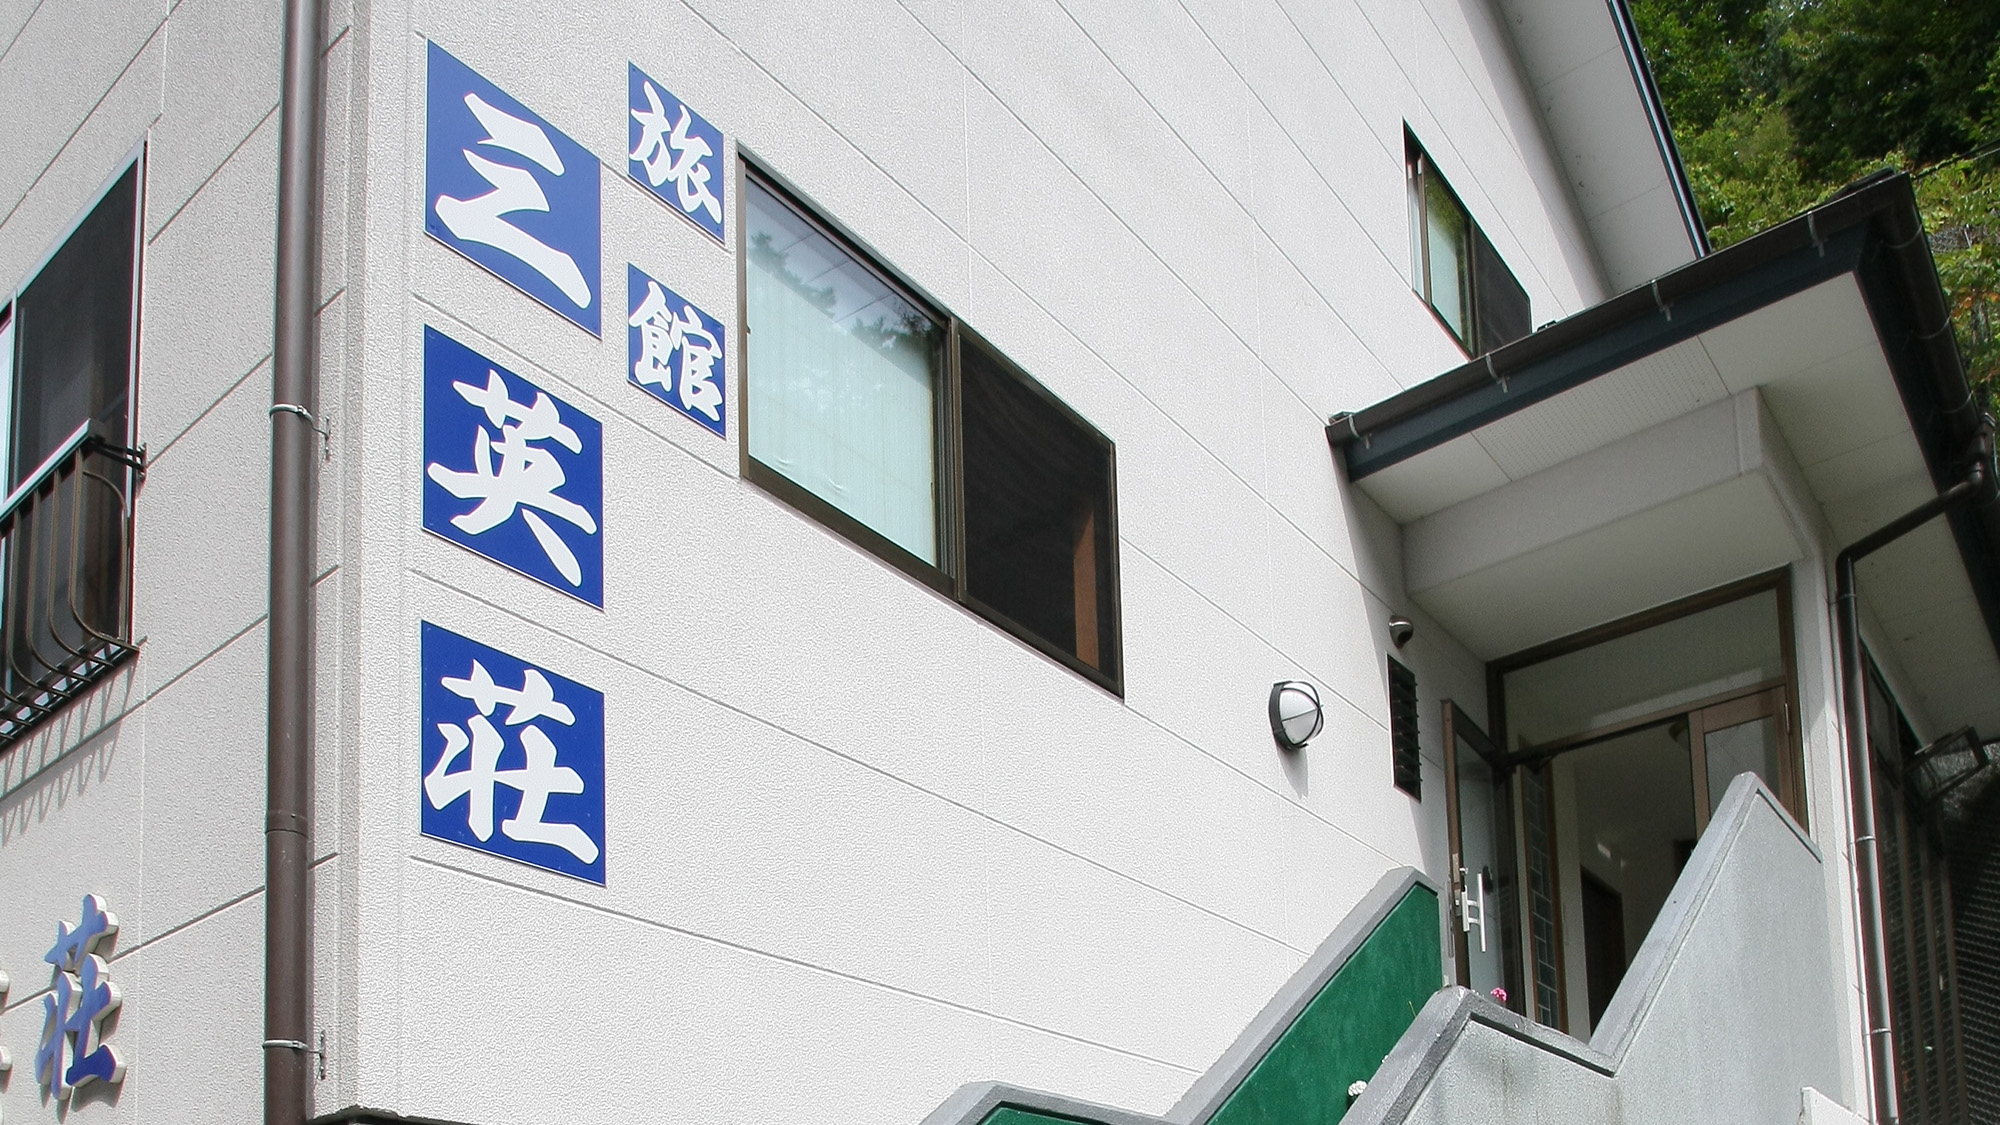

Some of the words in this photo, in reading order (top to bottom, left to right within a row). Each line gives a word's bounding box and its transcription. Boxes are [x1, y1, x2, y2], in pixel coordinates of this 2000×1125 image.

[424, 92, 599, 865] 三英荘
[628, 81, 723, 422] 旅館
